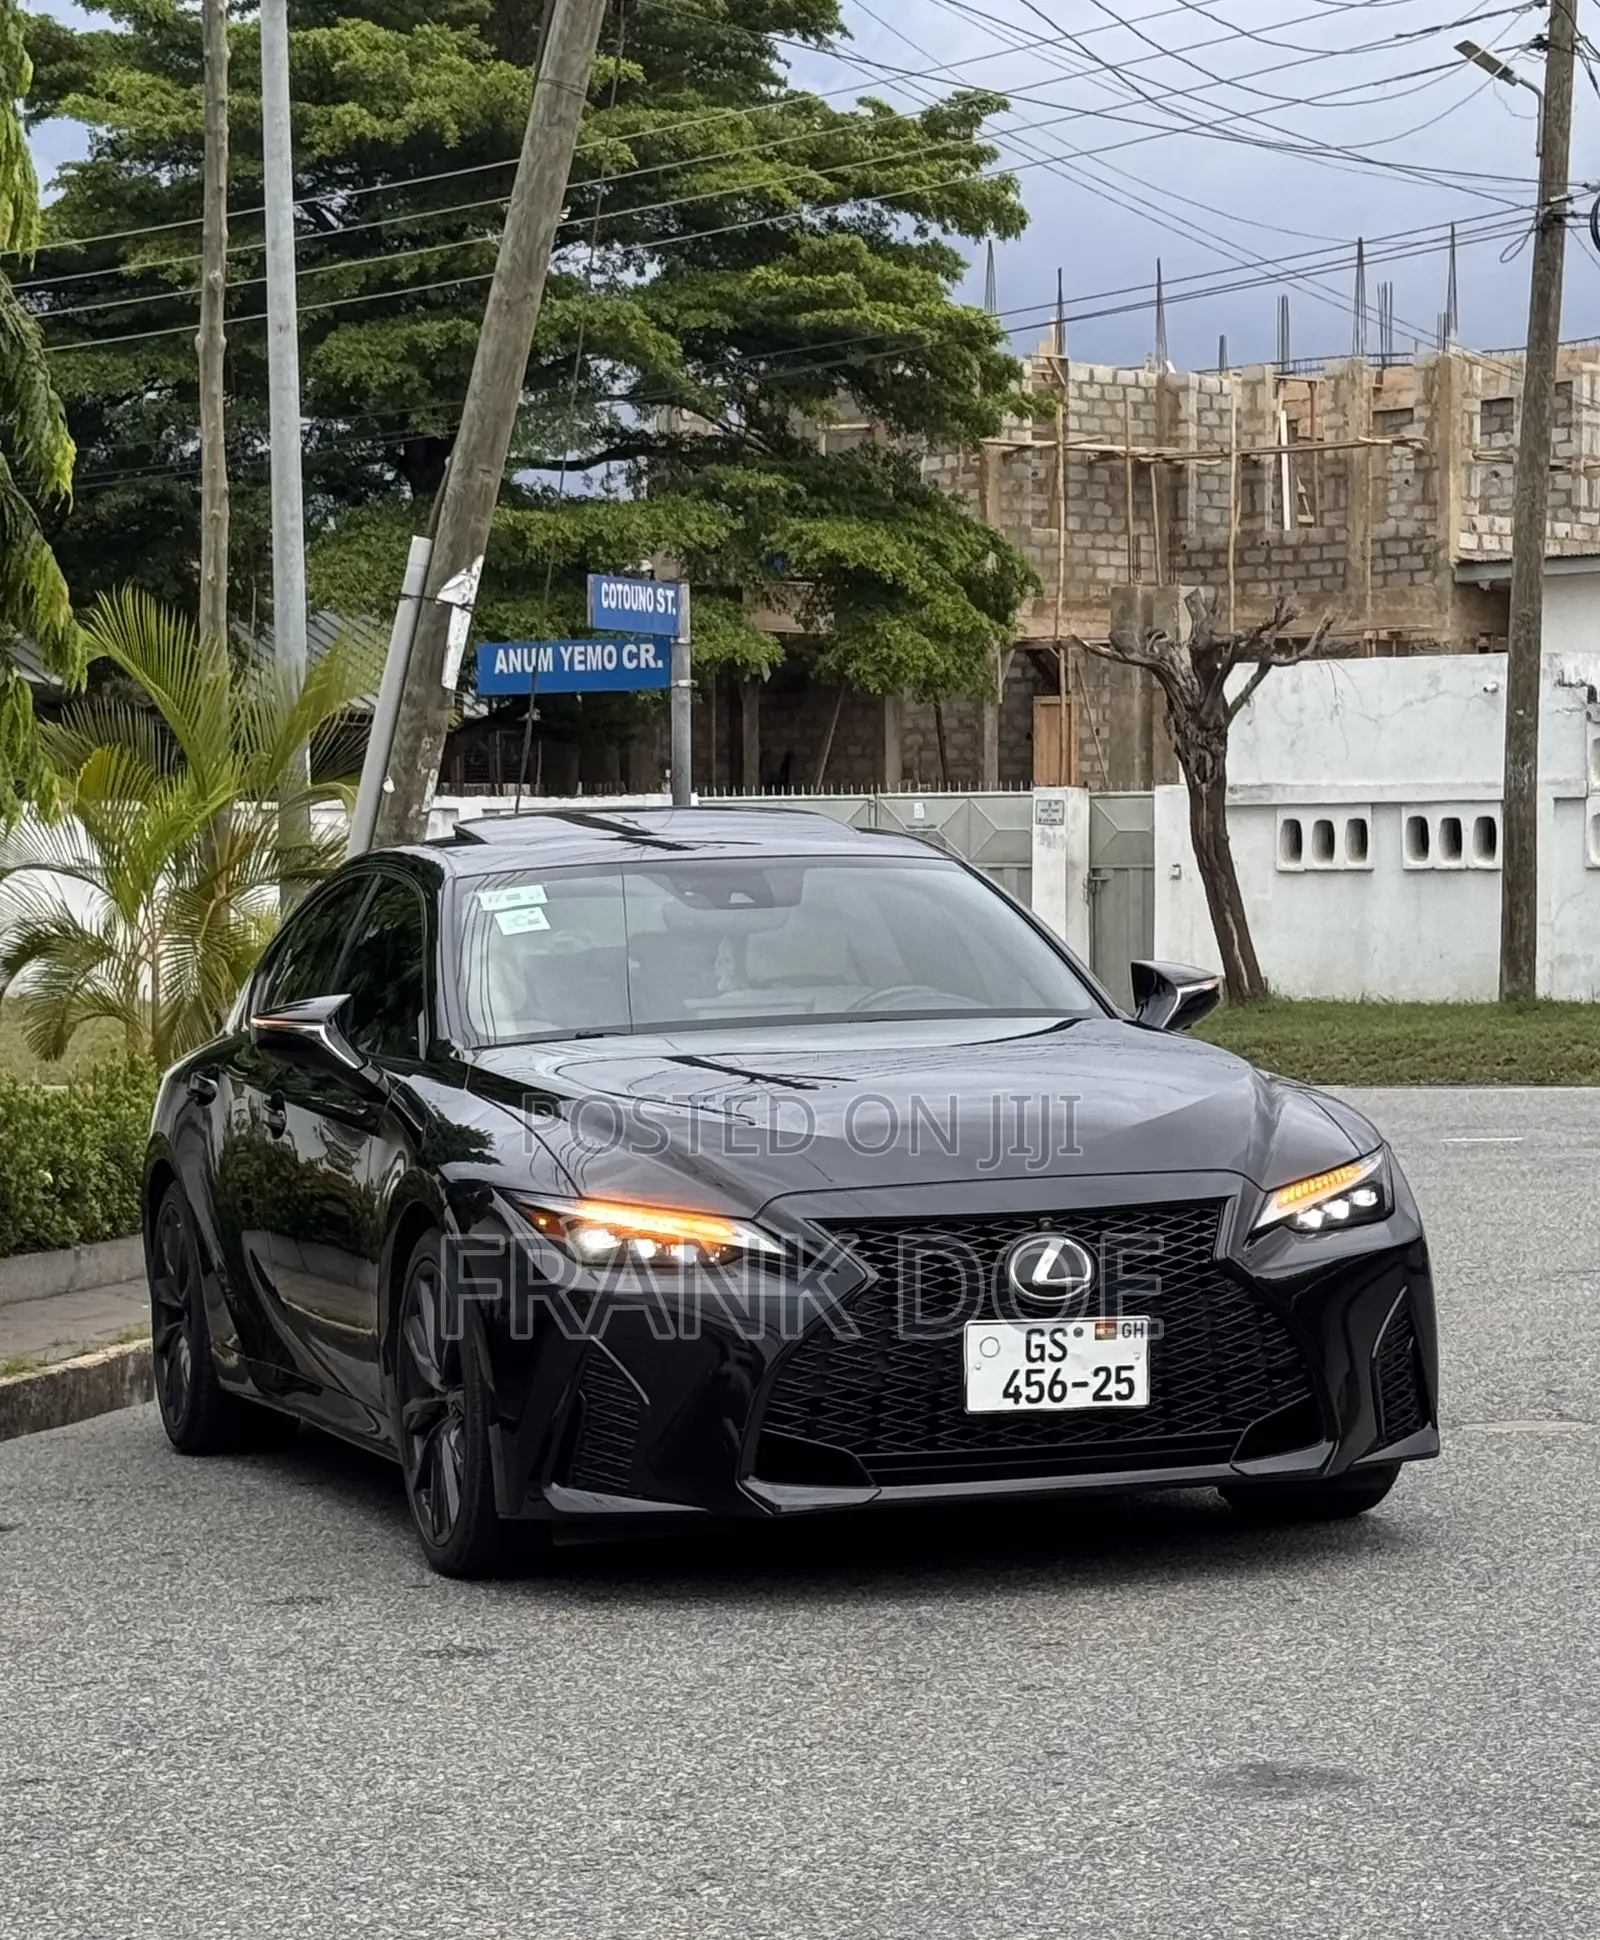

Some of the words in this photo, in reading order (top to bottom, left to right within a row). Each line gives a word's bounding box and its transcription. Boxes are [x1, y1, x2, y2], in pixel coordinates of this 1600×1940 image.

[601, 582, 654, 612] COTOUNO
[656, 588, 677, 615] ST.
[494, 647, 553, 674] ANUM
[559, 644, 617, 672] YEMO
[622, 643, 664, 669] CR.
[1025, 1327, 1068, 1363] GS
[1121, 1322, 1144, 1339] GH
[1002, 1364, 1136, 1405] 456-25
